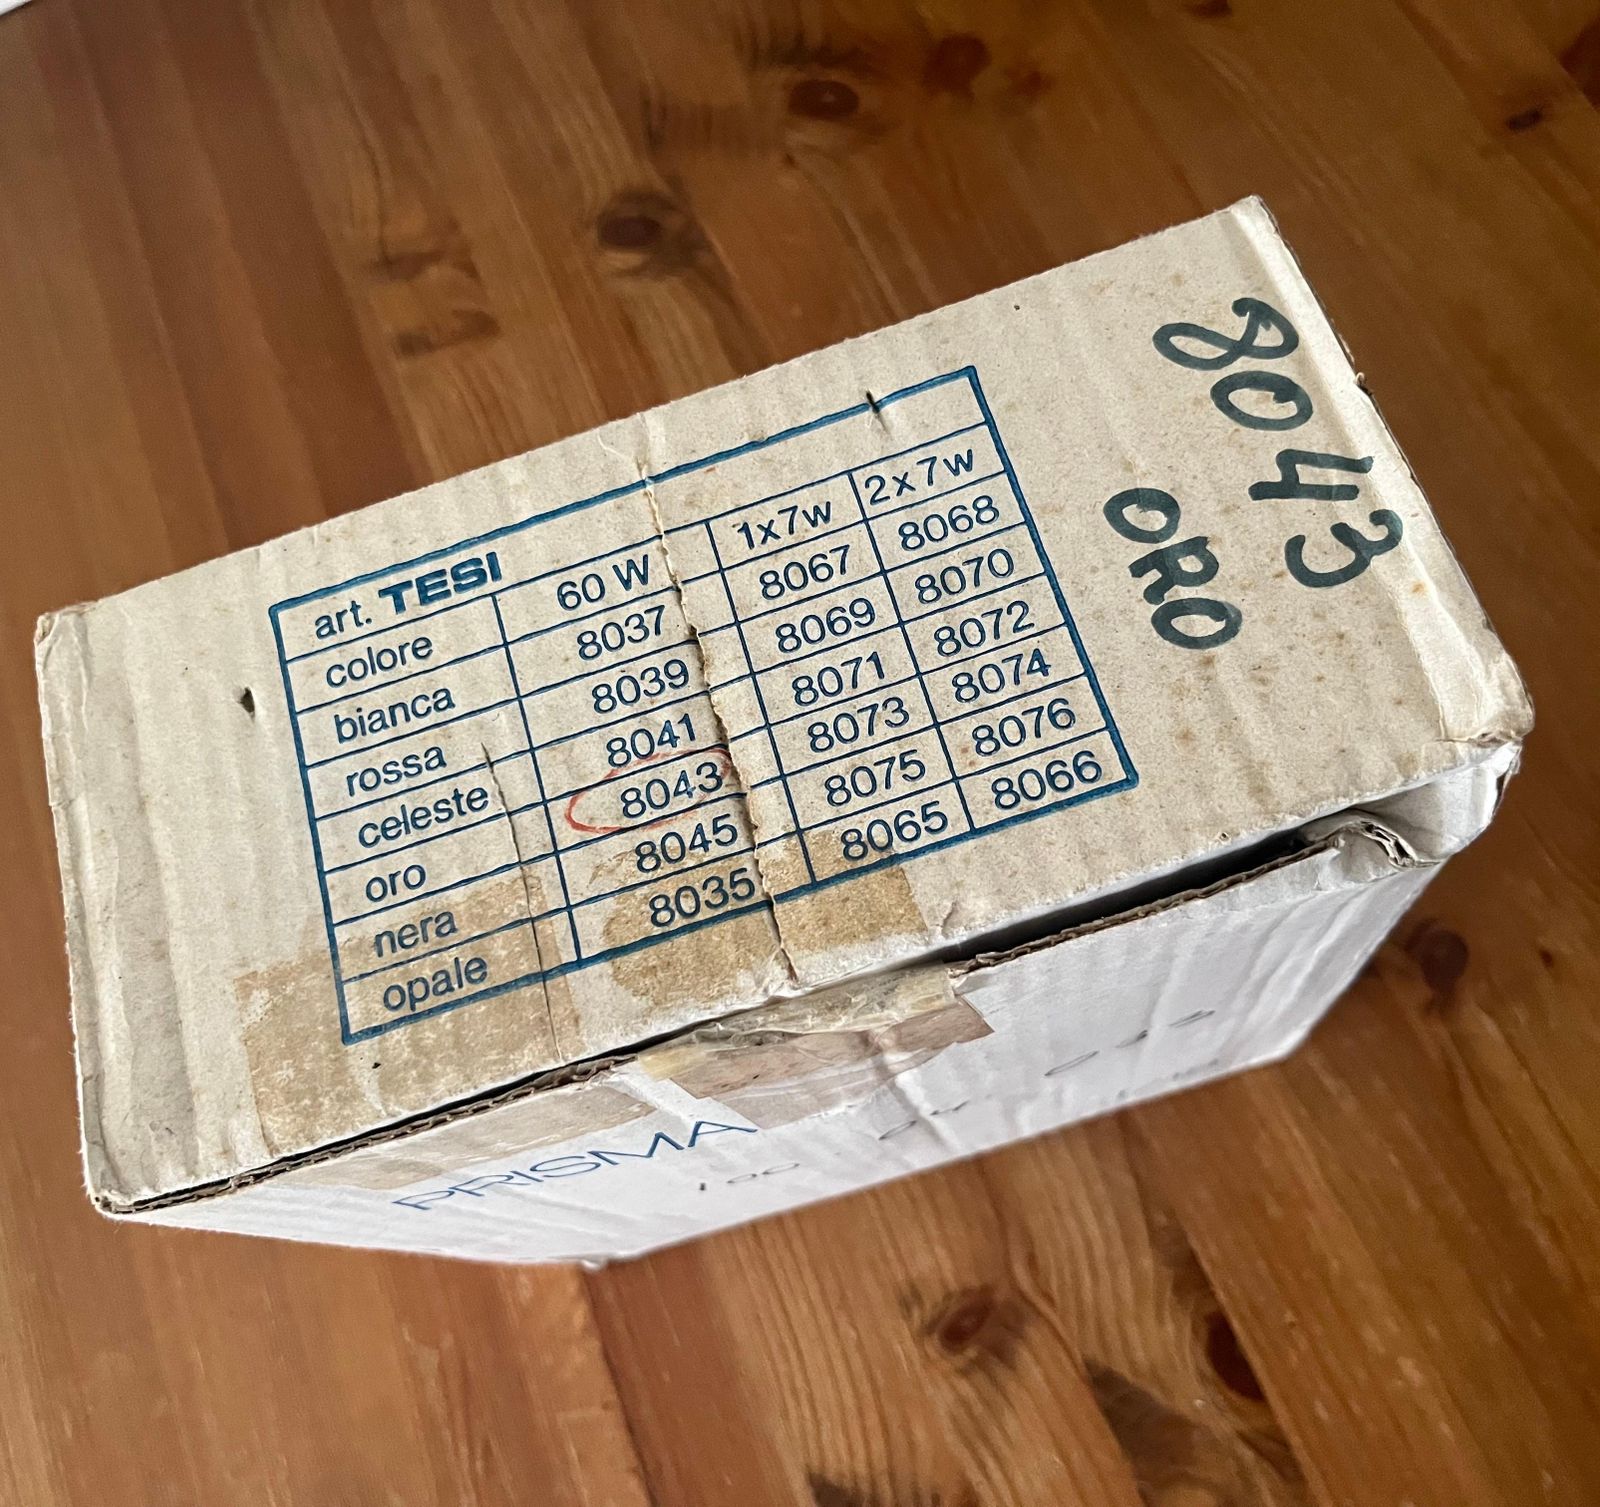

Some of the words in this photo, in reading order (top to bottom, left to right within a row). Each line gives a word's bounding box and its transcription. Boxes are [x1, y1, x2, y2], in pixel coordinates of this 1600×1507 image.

[1152, 297, 1403, 588] 8043
[315, 600, 372, 639] art.
[378, 551, 502, 615] TESI
[326, 636, 433, 688] colore
[556, 573, 606, 611] 60
[612, 554, 649, 591] W
[334, 688, 456, 744] bianca
[576, 605, 665, 661] 8037
[759, 544, 850, 600] 8067
[899, 494, 1000, 550] 8068
[346, 746, 447, 796] rossa
[591, 658, 689, 714] 8039
[774, 597, 875, 653] 8069
[914, 548, 1014, 604] 8070
[1103, 487, 1243, 650] ORO
[358, 787, 489, 848] celeste
[606, 713, 696, 768] 8041
[791, 651, 885, 707] 8071
[933, 600, 1034, 657] 8072
[365, 864, 427, 902] oro
[620, 762, 723, 819] 8043
[807, 697, 909, 753] 8073
[951, 648, 1051, 704] 8074
[374, 911, 458, 958] nera
[635, 813, 738, 873] 8045
[824, 749, 926, 807] 8075
[971, 697, 1076, 757] 8076
[383, 956, 488, 1011] opale
[649, 867, 755, 928] 8035
[841, 800, 948, 861] 8065
[990, 750, 1102, 810] 8066
[391, 1120, 758, 1211] PRISMA
